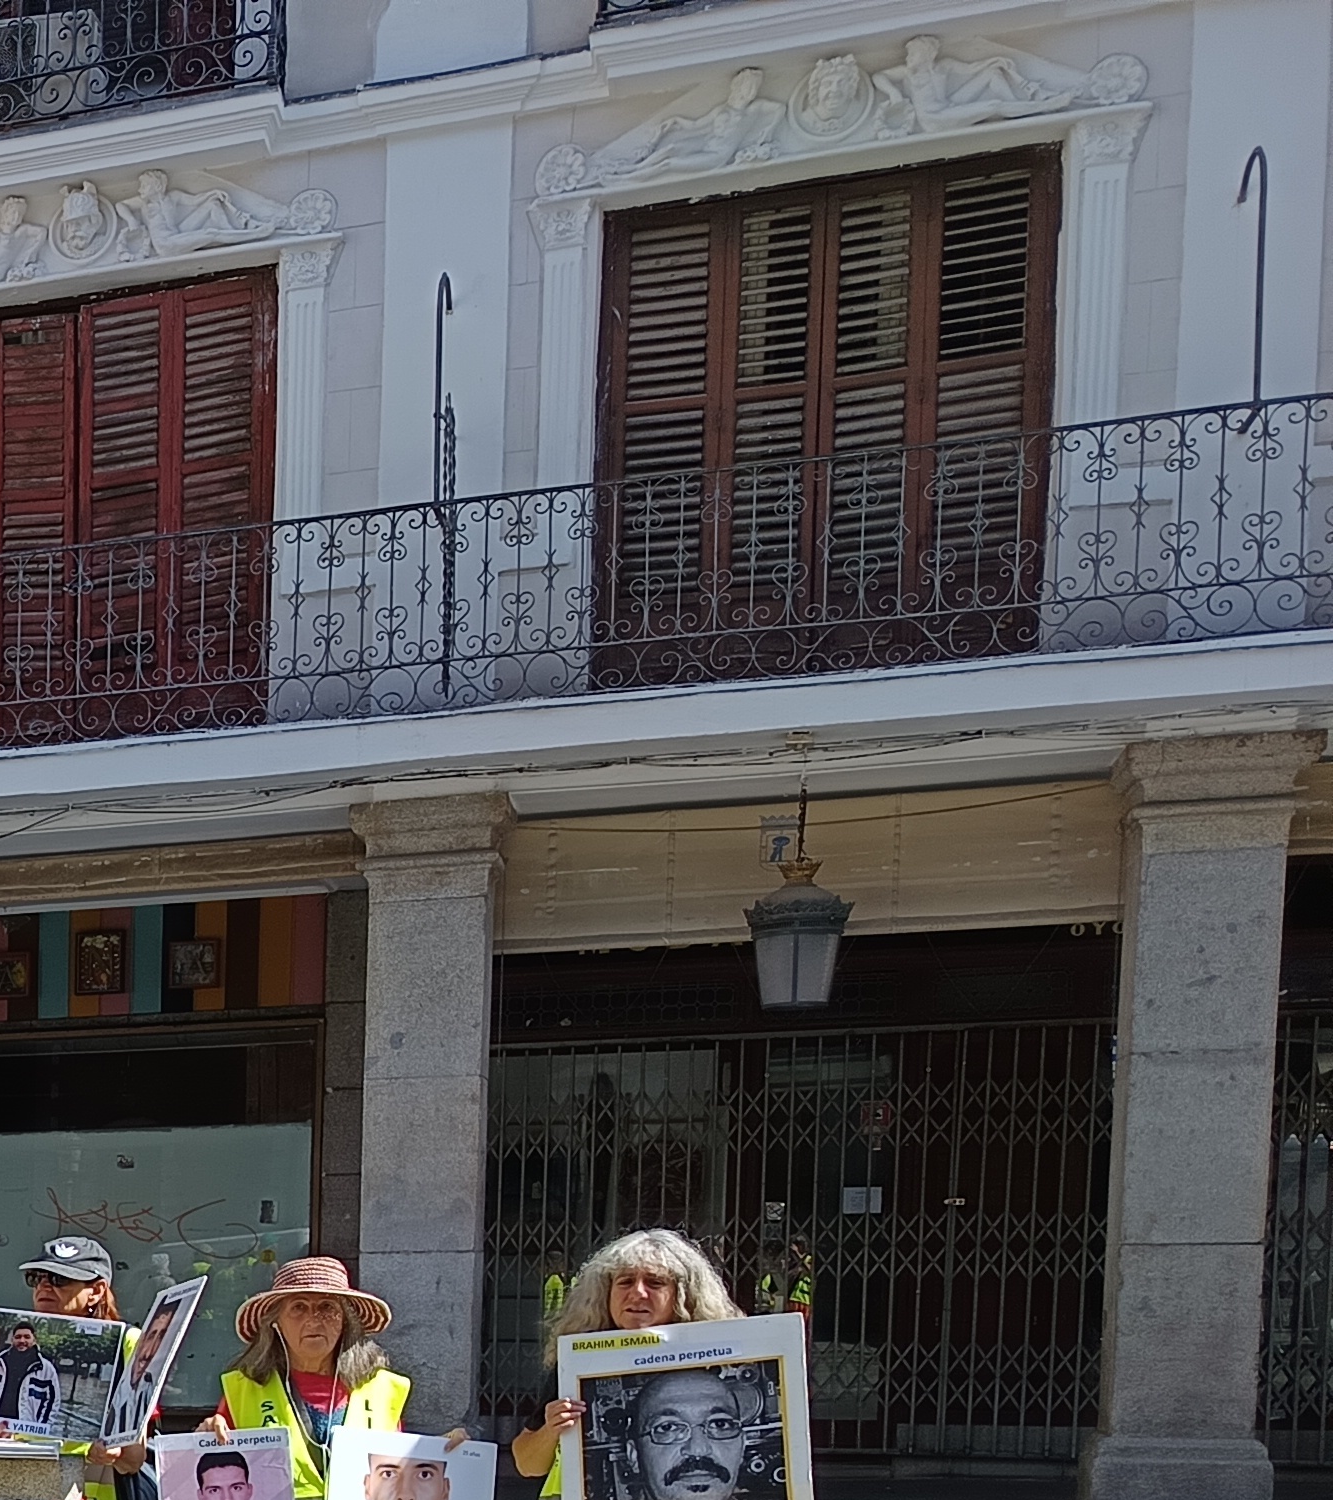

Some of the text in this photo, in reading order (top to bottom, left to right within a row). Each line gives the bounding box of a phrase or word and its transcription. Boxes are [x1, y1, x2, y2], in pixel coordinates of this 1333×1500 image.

[572, 1339, 615, 1351] BRAHIM
[634, 1347, 733, 1367] cadena perpetua
[12, 1423, 48, 1436] YATRIBI
[237, 1434, 282, 1448] perpetua
